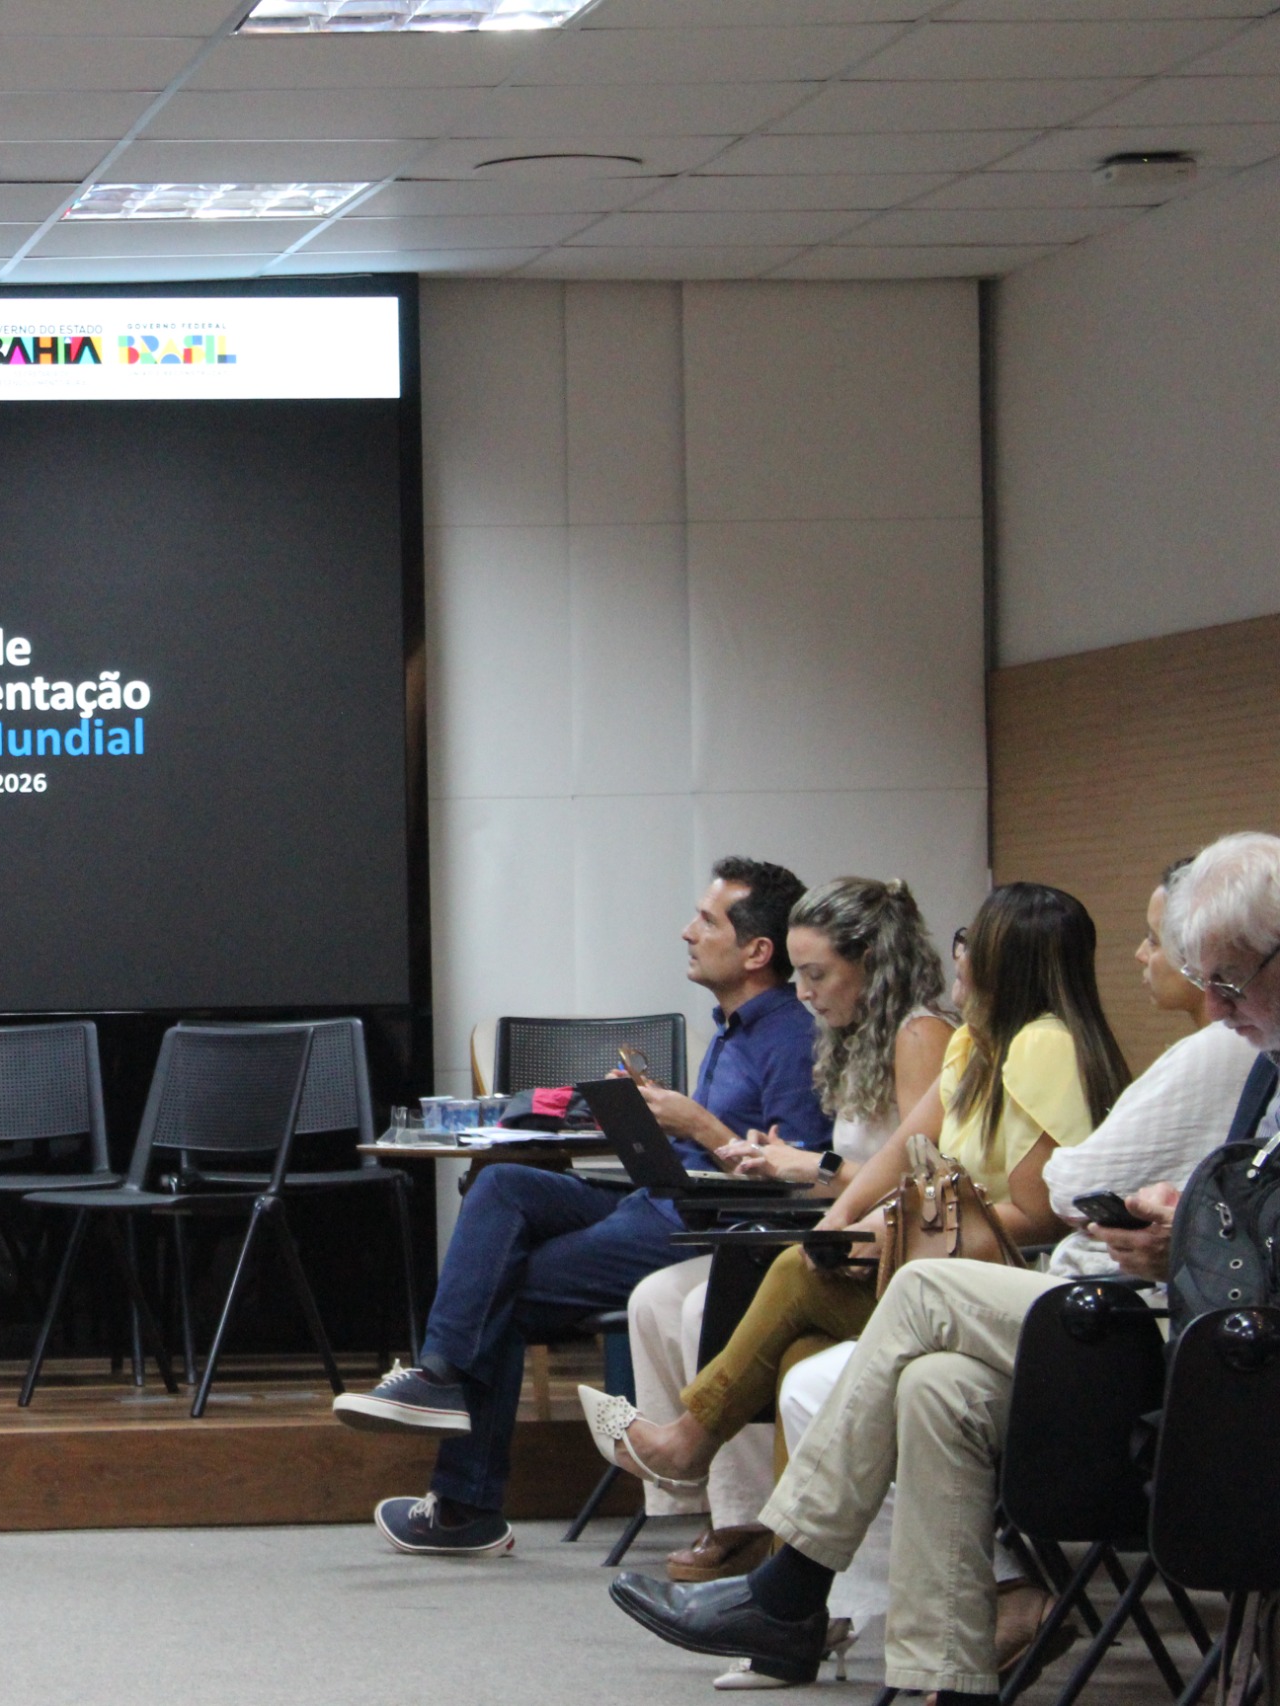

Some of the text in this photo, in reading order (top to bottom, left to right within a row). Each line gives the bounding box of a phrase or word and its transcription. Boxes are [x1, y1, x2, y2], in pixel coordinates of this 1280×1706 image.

[39, 325, 56, 335] DO
[59, 325, 103, 335] ESTADO
[117, 335, 237, 364] BRASIL
